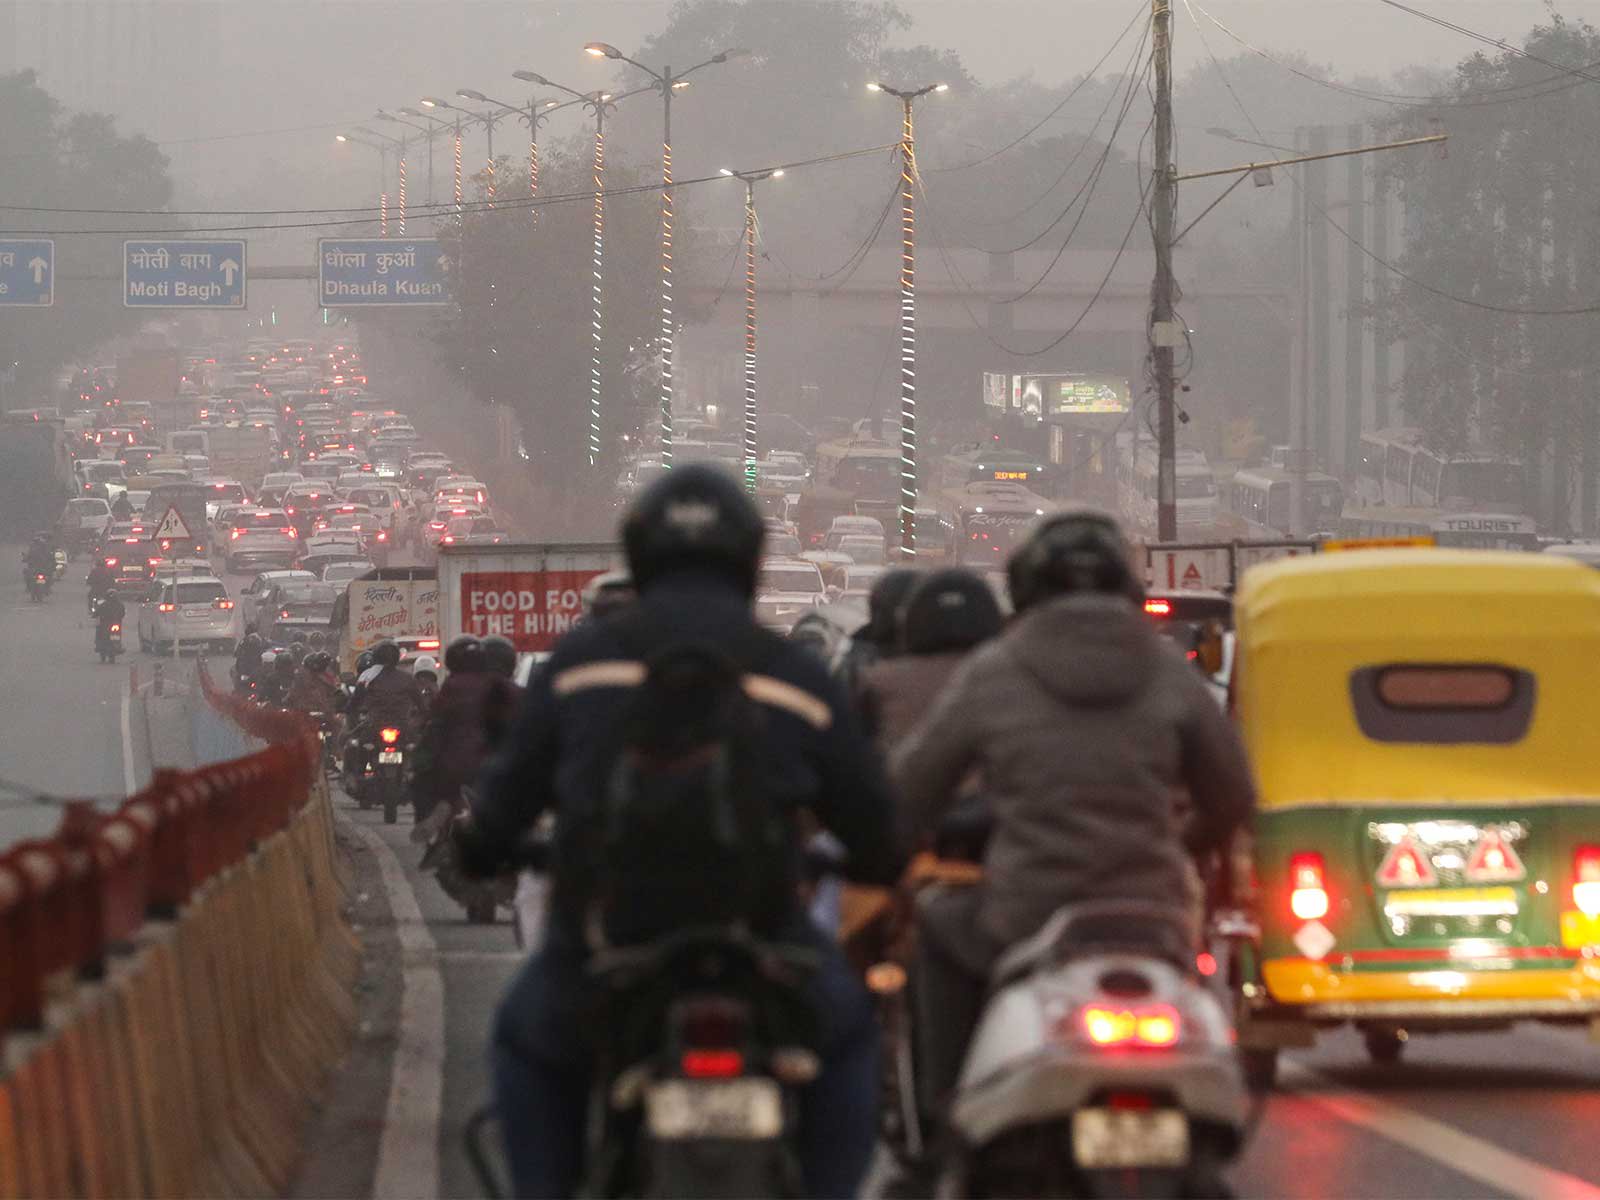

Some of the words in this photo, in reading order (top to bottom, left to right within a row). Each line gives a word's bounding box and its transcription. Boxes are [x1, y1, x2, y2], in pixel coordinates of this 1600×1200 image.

[130, 248, 170, 269] मोती
[180, 254, 211, 269] बाग
[130, 281, 169, 297] Moti
[174, 281, 221, 300] Bagh
[325, 280, 388, 296] Dhaula
[395, 280, 441, 296] Kuan
[1445, 519, 1521, 532] TOURIST
[470, 590, 535, 611] FOOD
[471, 613, 515, 635] THE
